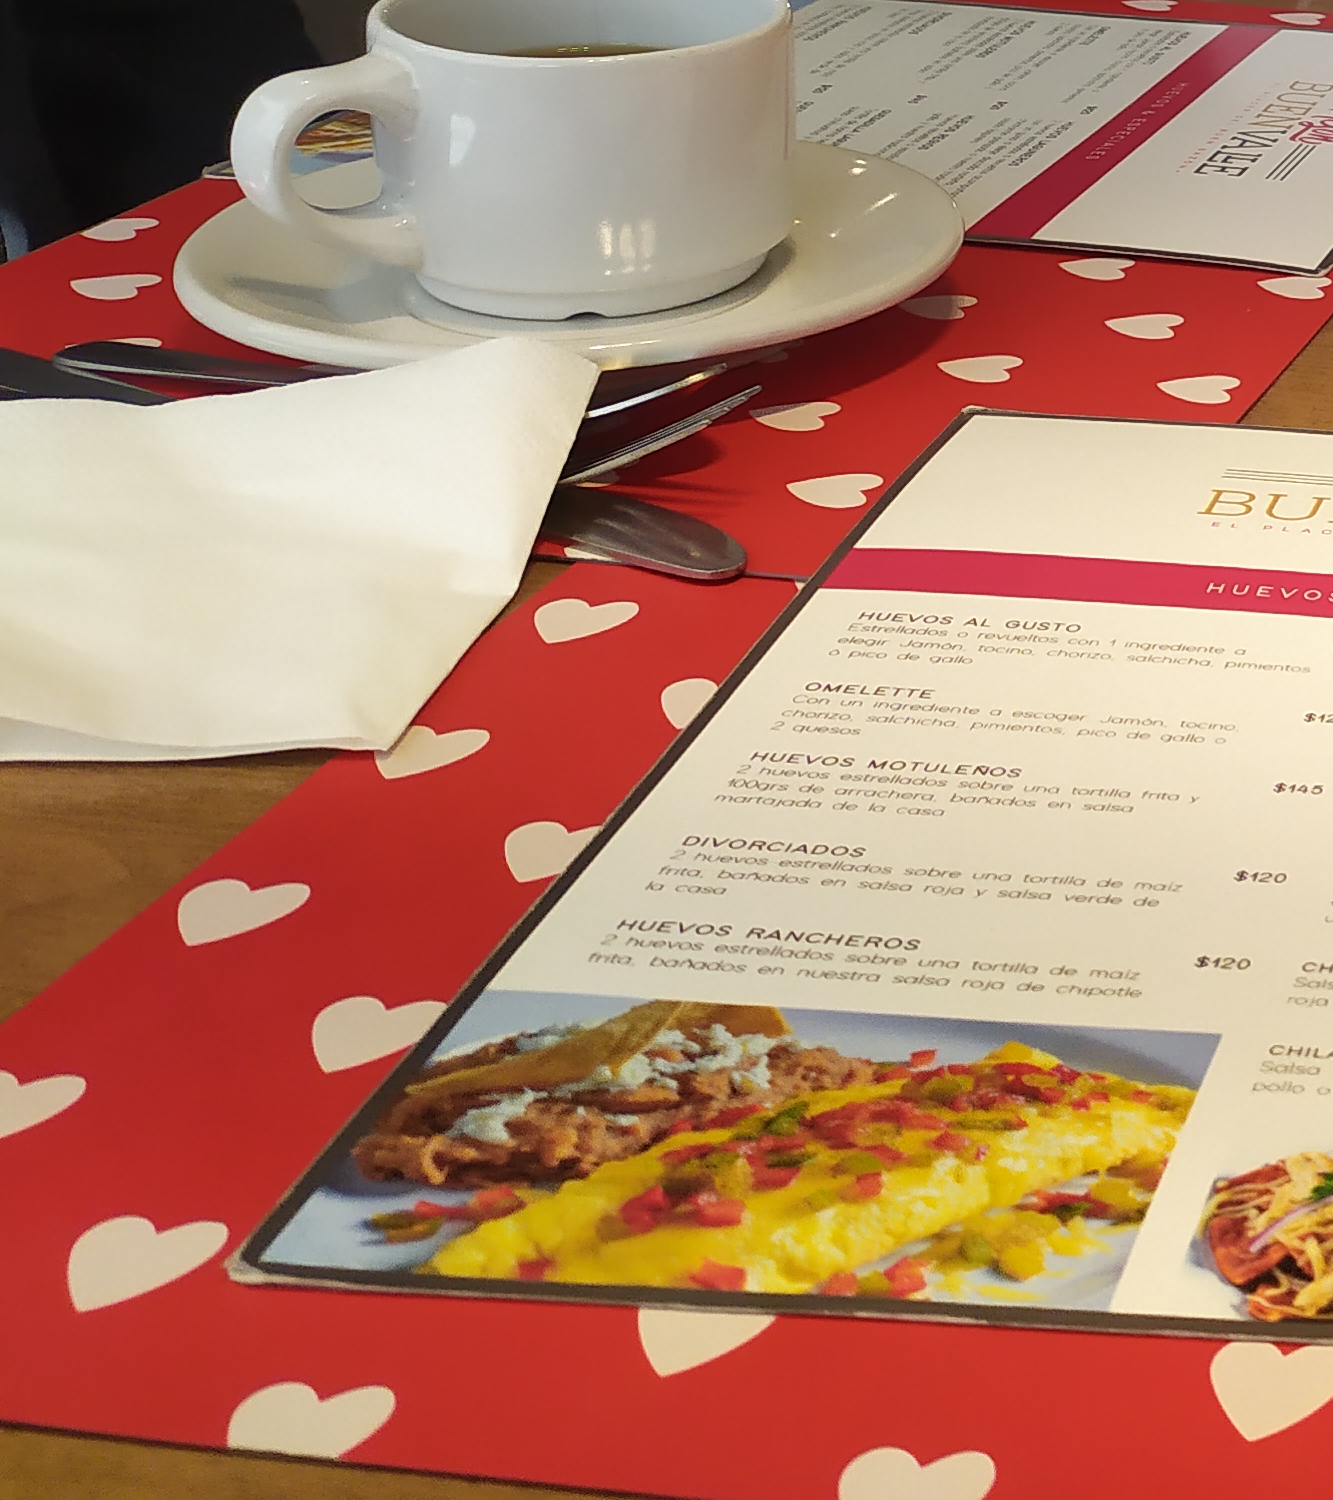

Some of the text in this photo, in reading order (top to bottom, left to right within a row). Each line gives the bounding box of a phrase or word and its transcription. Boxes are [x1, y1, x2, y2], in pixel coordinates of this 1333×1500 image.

[1211, 521, 1240, 529] EL
[858, 611, 1081, 632] HUEVOS AL GUSTO
[847, 622, 948, 636] Estrellados
[976, 632, 1059, 644] revueltos
[1067, 638, 1100, 646] con
[1124, 641, 1225, 654] ingrediente
[1233, 648, 1247, 656] a
[836, 635, 889, 646] elegir
[1223, 661, 1311, 673] pimientos
[847, 650, 888, 659] pico
[896, 652, 920, 661] de
[929, 655, 973, 664] gallo
[804, 681, 935, 699] OMELETTE
[792, 694, 831, 705] Con
[839, 699, 864, 707] un
[872, 701, 980, 715] ingrediente
[989, 708, 1003, 716] a
[1011, 710, 1085, 722] escoger
[769, 722, 861, 736] 2 quesos
[1076, 728, 1117, 737] pico
[1126, 730, 1151, 740] de
[1159, 733, 1206, 743] gallo
[749, 751, 855, 767] HUEVOS
[735, 764, 1200, 804] 2 huevos estrellados sobre una tortilla frita y
[1272, 781, 1323, 795] $145
[727, 777, 789, 792] 100grs
[798, 783, 825, 794] de
[1047, 800, 1072, 809] en
[1083, 802, 1134, 813] salsa
[713, 794, 945, 817] martajada de la casa
[681, 835, 867, 857] DIVORCIADOS
[669, 851, 687, 860] 2
[693, 852, 769, 866] huevos
[778, 859, 893, 874] estrellados
[903, 867, 962, 879] sobre
[971, 872, 1012, 882] una
[1022, 873, 1087, 886] tortilla
[1096, 877, 1124, 889] de
[1233, 869, 1287, 883] $120
[644, 880, 727, 895] la casa
[820, 878, 847, 887] en
[856, 880, 913, 892] salsa
[923, 884, 965, 896] roja
[974, 888, 988, 898] y
[996, 888, 1052, 900] salsa
[1064, 893, 1123, 905] verde
[1132, 896, 1160, 907] de
[616, 919, 921, 950] HUEVOS RANCHEROS
[1194, 955, 1251, 970] $120
[1287, 996, 1329, 1007] roja
